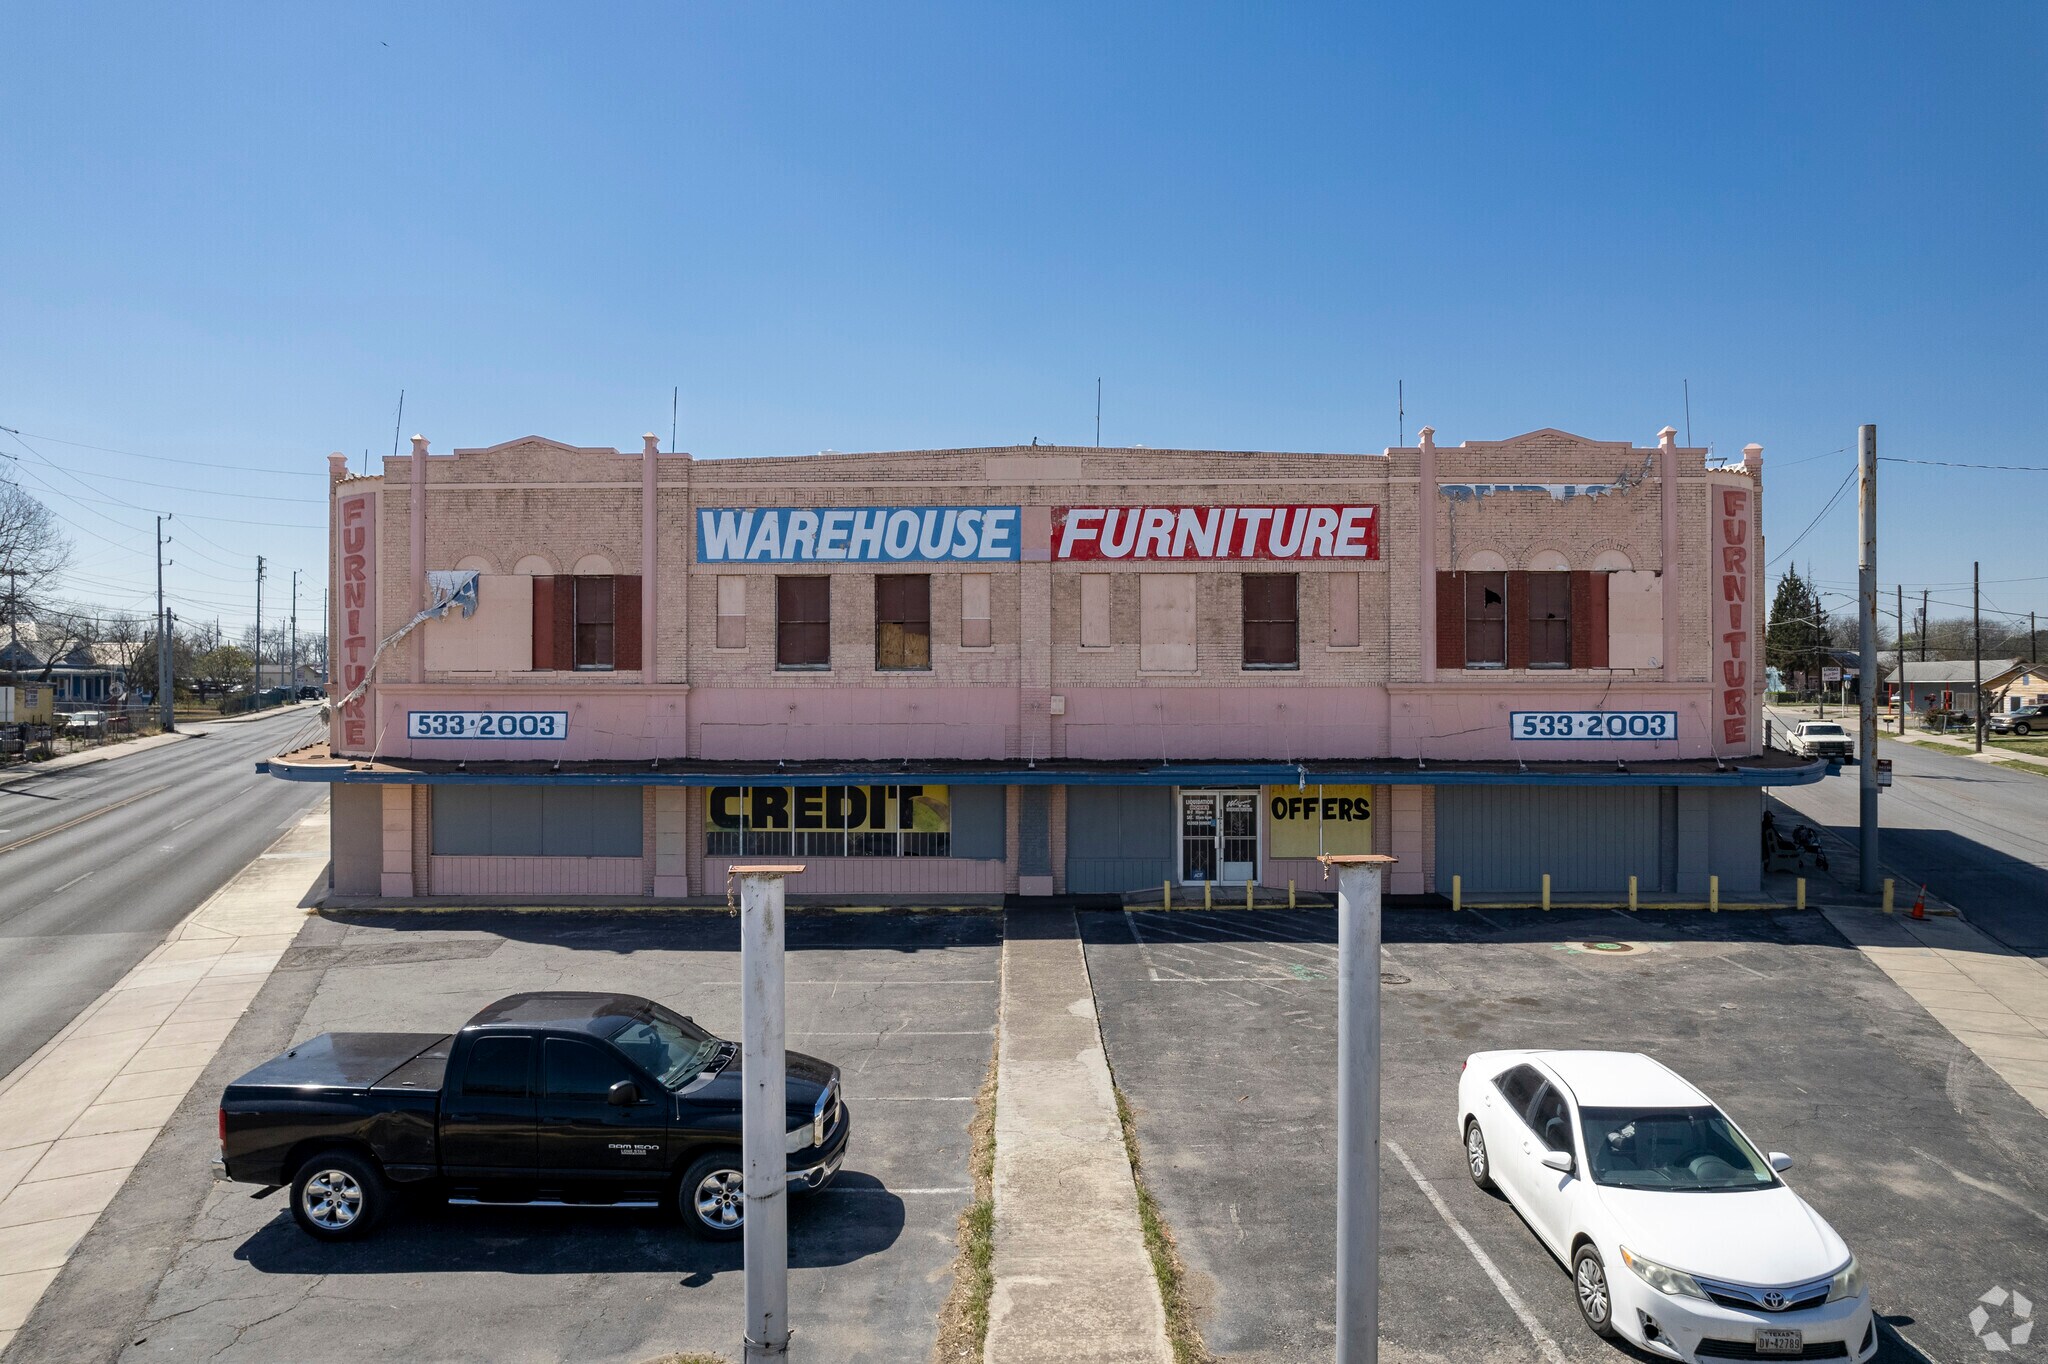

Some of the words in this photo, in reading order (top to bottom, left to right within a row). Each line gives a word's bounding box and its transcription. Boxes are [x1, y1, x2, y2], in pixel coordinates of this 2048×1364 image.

[700, 509, 1017, 560] WAREHOUSE
[1057, 506, 1375, 559] FURNITURE
[343, 498, 367, 746] FURNITURE
[1722, 490, 1747, 744] FURNITURE
[709, 785, 924, 830] CREDIT
[1271, 796, 1371, 822] OFFERS
